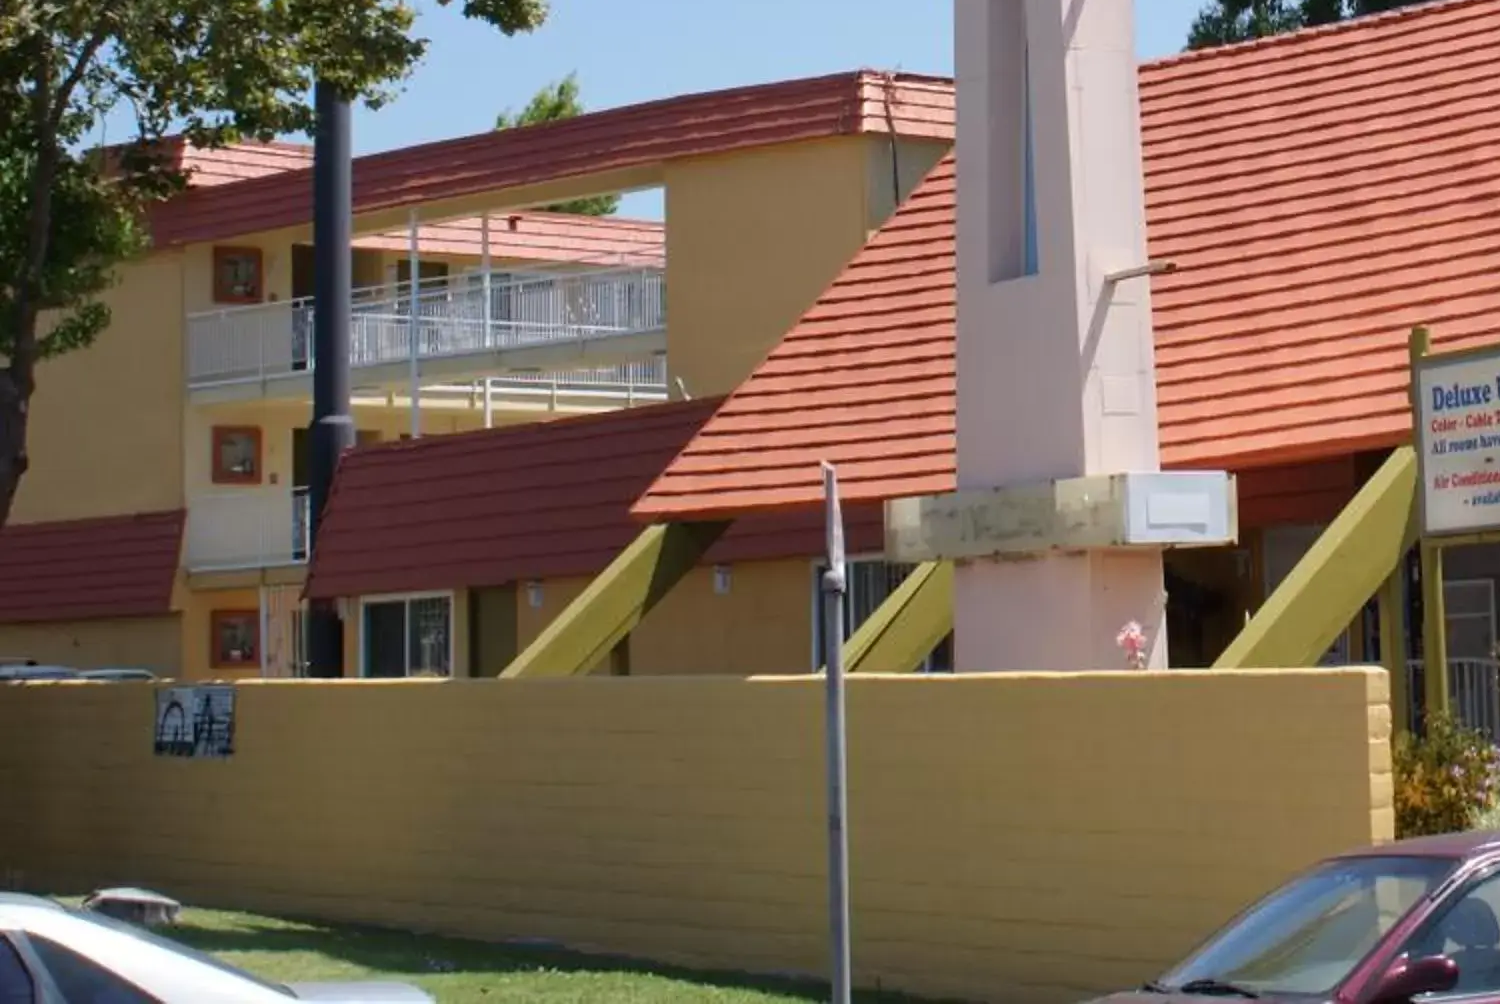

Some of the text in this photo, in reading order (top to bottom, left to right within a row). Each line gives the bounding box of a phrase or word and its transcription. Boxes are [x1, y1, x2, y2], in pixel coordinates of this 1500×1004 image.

[1432, 382, 1491, 411] Deluxe
[1431, 417, 1457, 432] Color
[1465, 412, 1493, 428] Cable
[1431, 439, 1447, 455] All
[1449, 437, 1478, 453] rooms
[1434, 473, 1449, 489] Air
